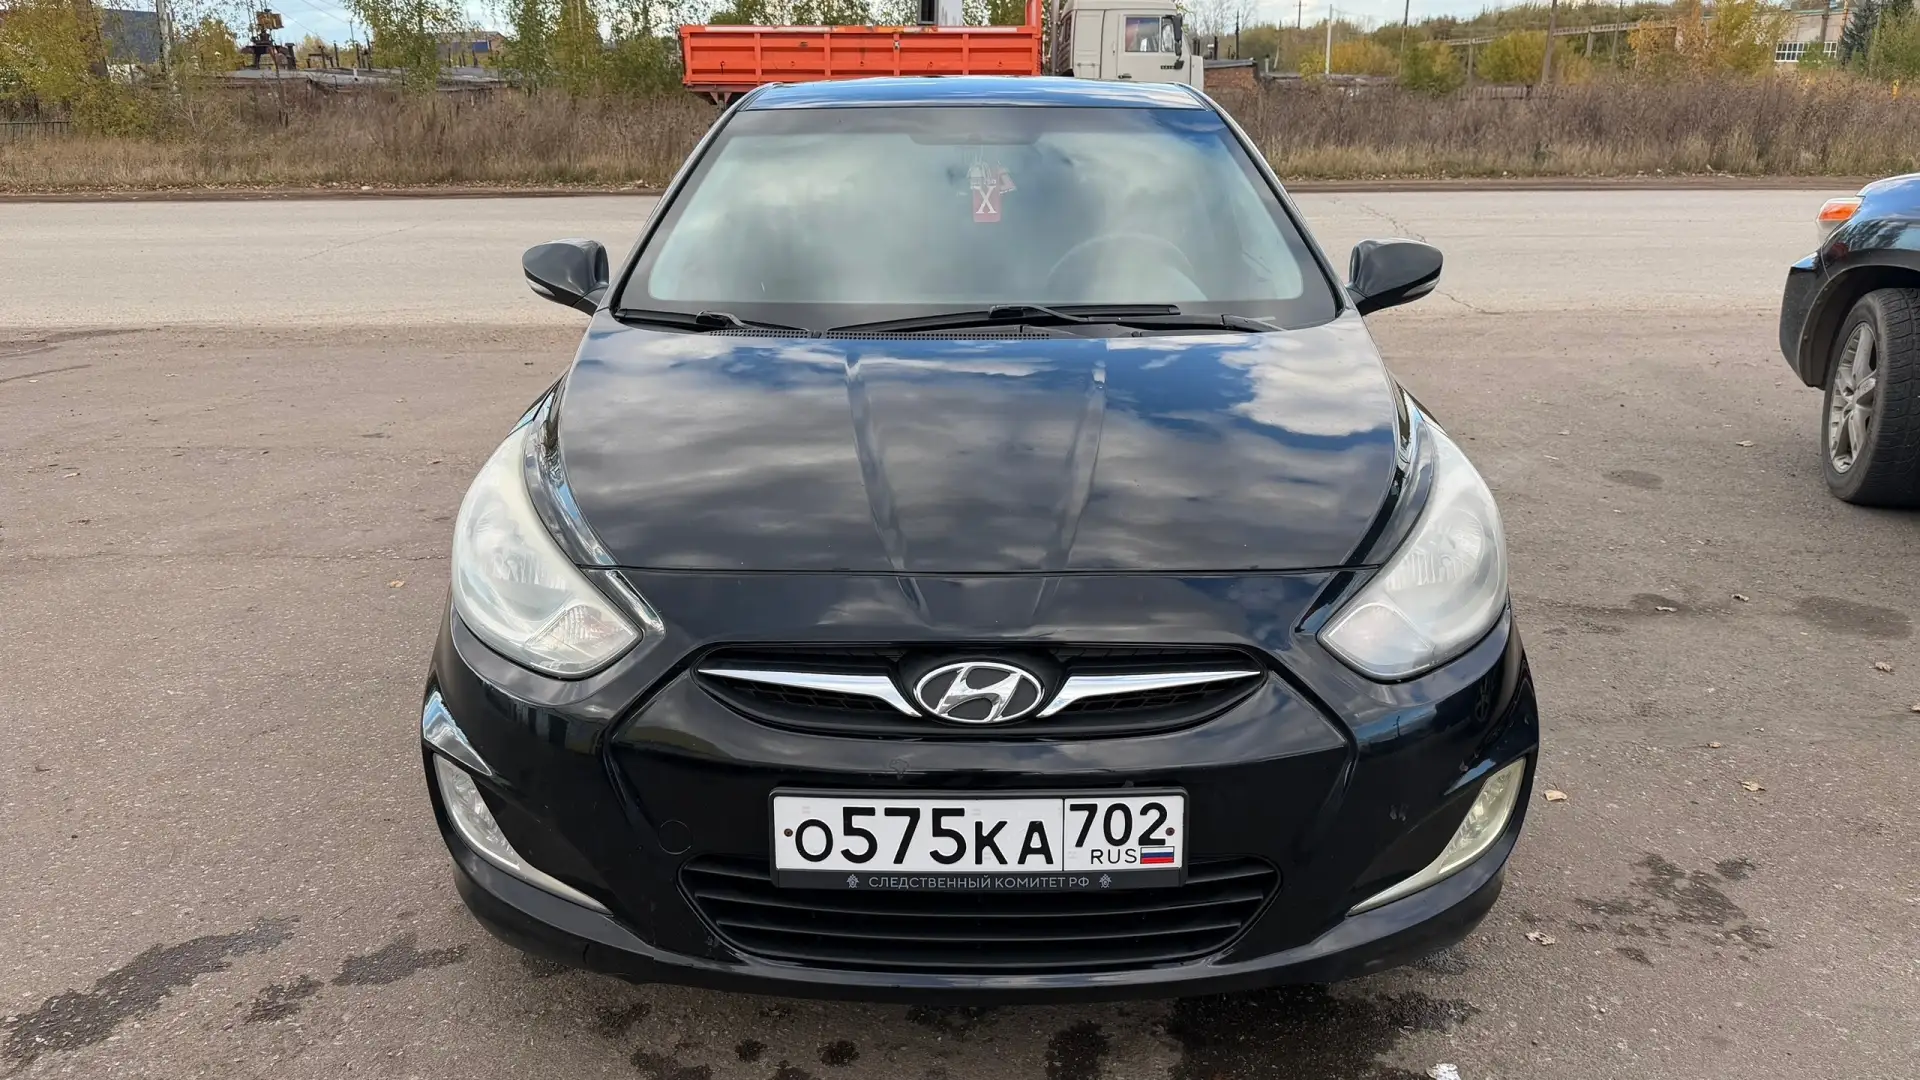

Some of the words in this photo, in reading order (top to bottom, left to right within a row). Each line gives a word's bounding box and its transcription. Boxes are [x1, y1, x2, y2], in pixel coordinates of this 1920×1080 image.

[1069, 801, 1168, 848] 702
[1090, 848, 1138, 865] RUS
[868, 875, 991, 889] СЛЕДСТВЕННЫЙ
[995, 876, 1067, 889] КОМИТЕТ
[1068, 876, 1090, 888] РФ
